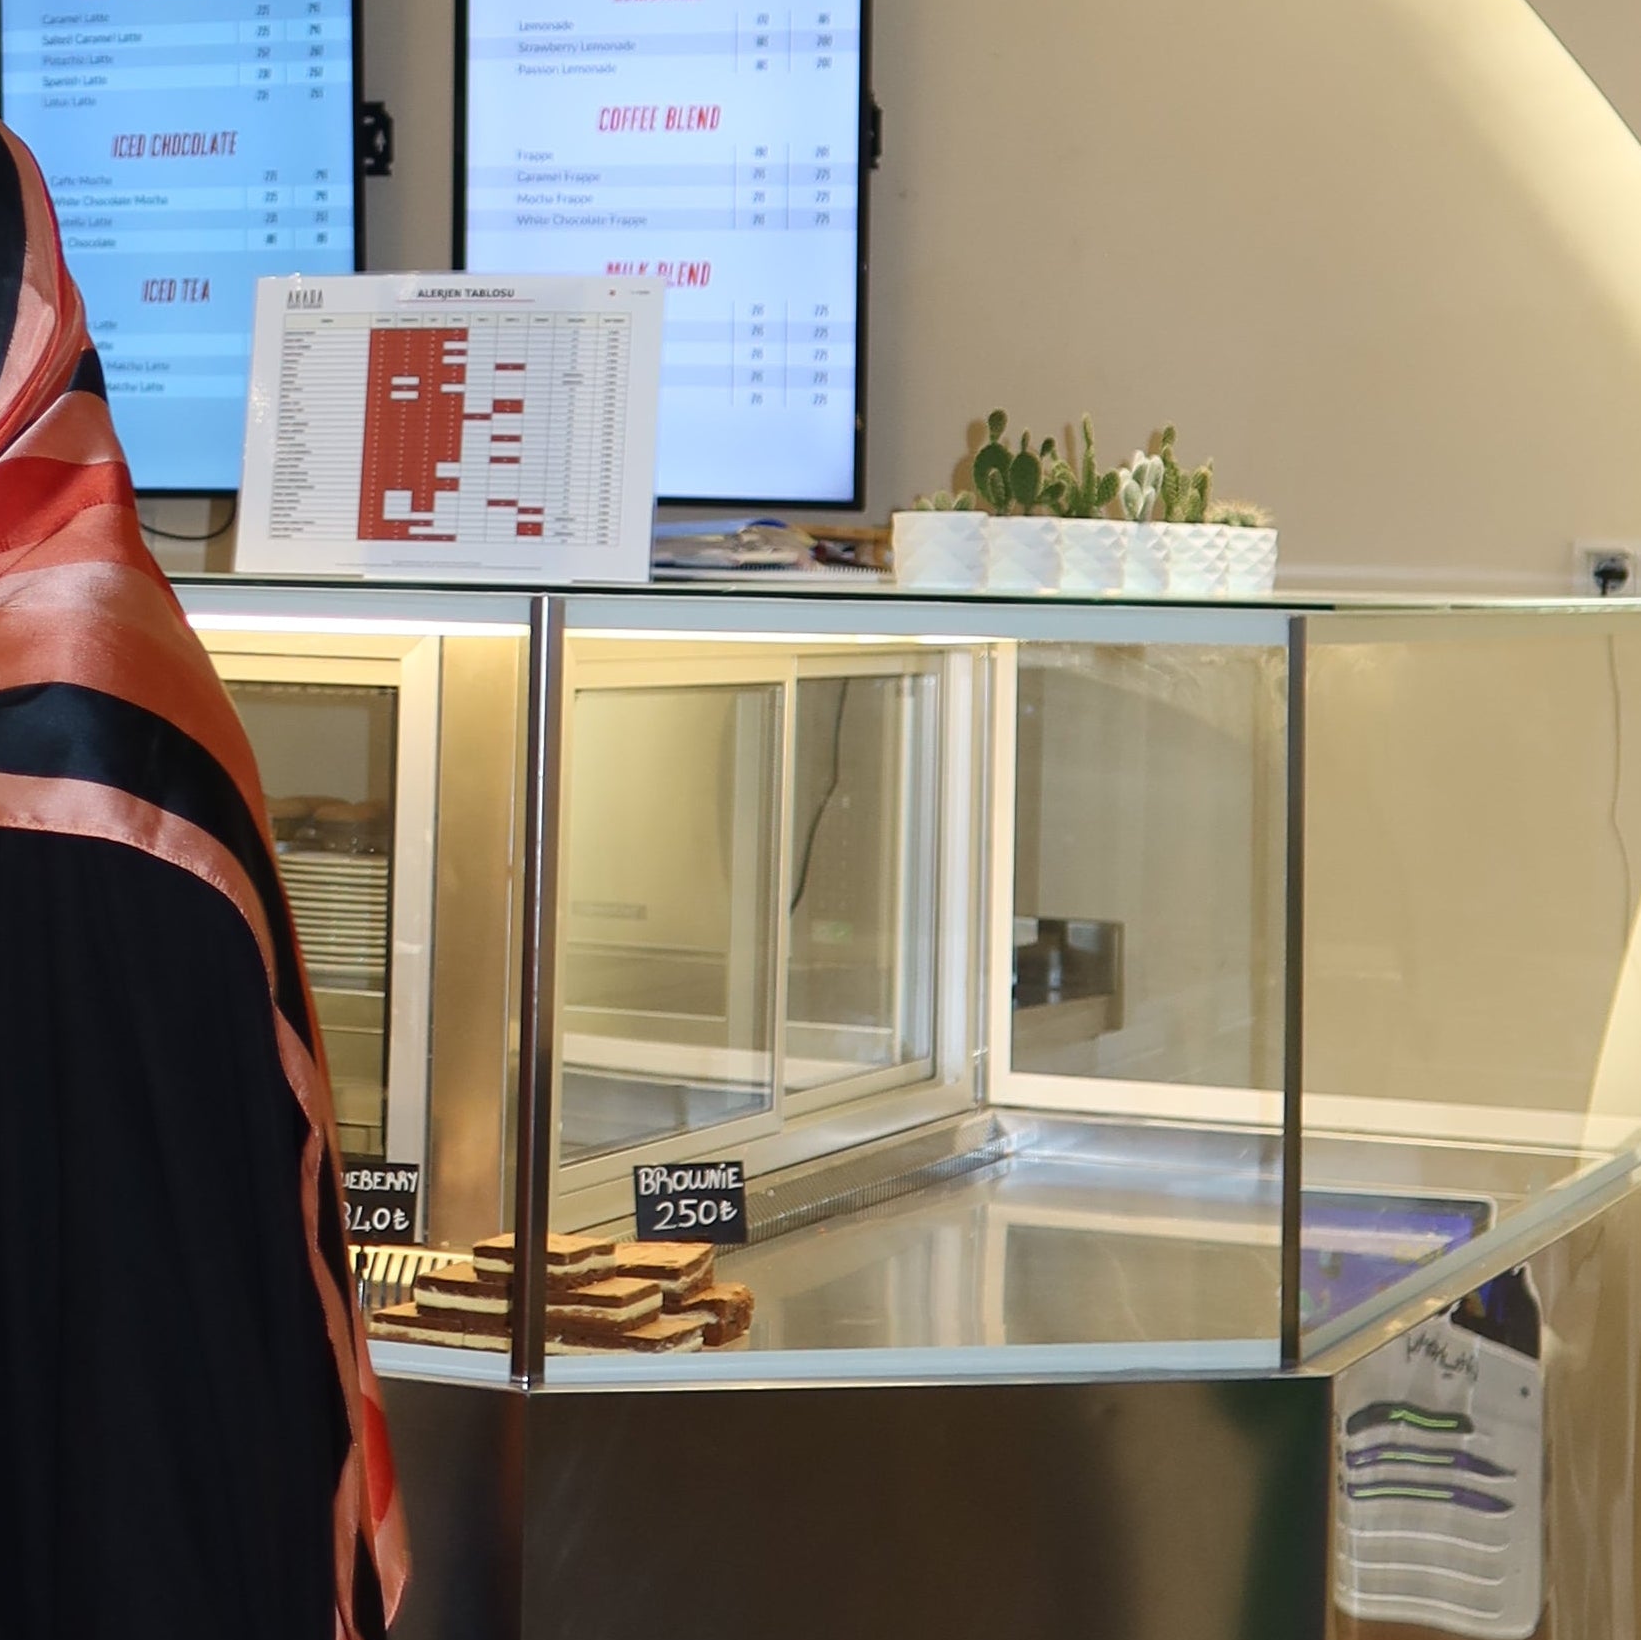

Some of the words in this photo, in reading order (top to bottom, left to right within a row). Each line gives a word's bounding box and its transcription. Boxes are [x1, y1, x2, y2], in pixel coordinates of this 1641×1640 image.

[519, 21, 574, 31] Lemonade
[519, 43, 578, 54] Strawberry
[581, 41, 635, 52] Lemonade
[561, 63, 616, 74] Lemonade
[599, 106, 659, 132] COFFEE
[665, 106, 720, 130] BLEND
[113, 134, 146, 158] ICED
[150, 131, 237, 157] CHOCOLATE
[517, 151, 552, 161] Frappe
[564, 170, 599, 183] Frappe
[517, 194, 557, 205] Mocha
[557, 194, 593, 204] Frappe
[552, 214, 605, 225] Chocolate
[610, 214, 647, 226] Frappe
[142, 278, 176, 303] ICED
[182, 278, 209, 302] TEA
[417, 289, 462, 300] ALERJEN
[464, 288, 515, 298] TABLOSU
[340, 1169, 418, 1193] UEBERRY
